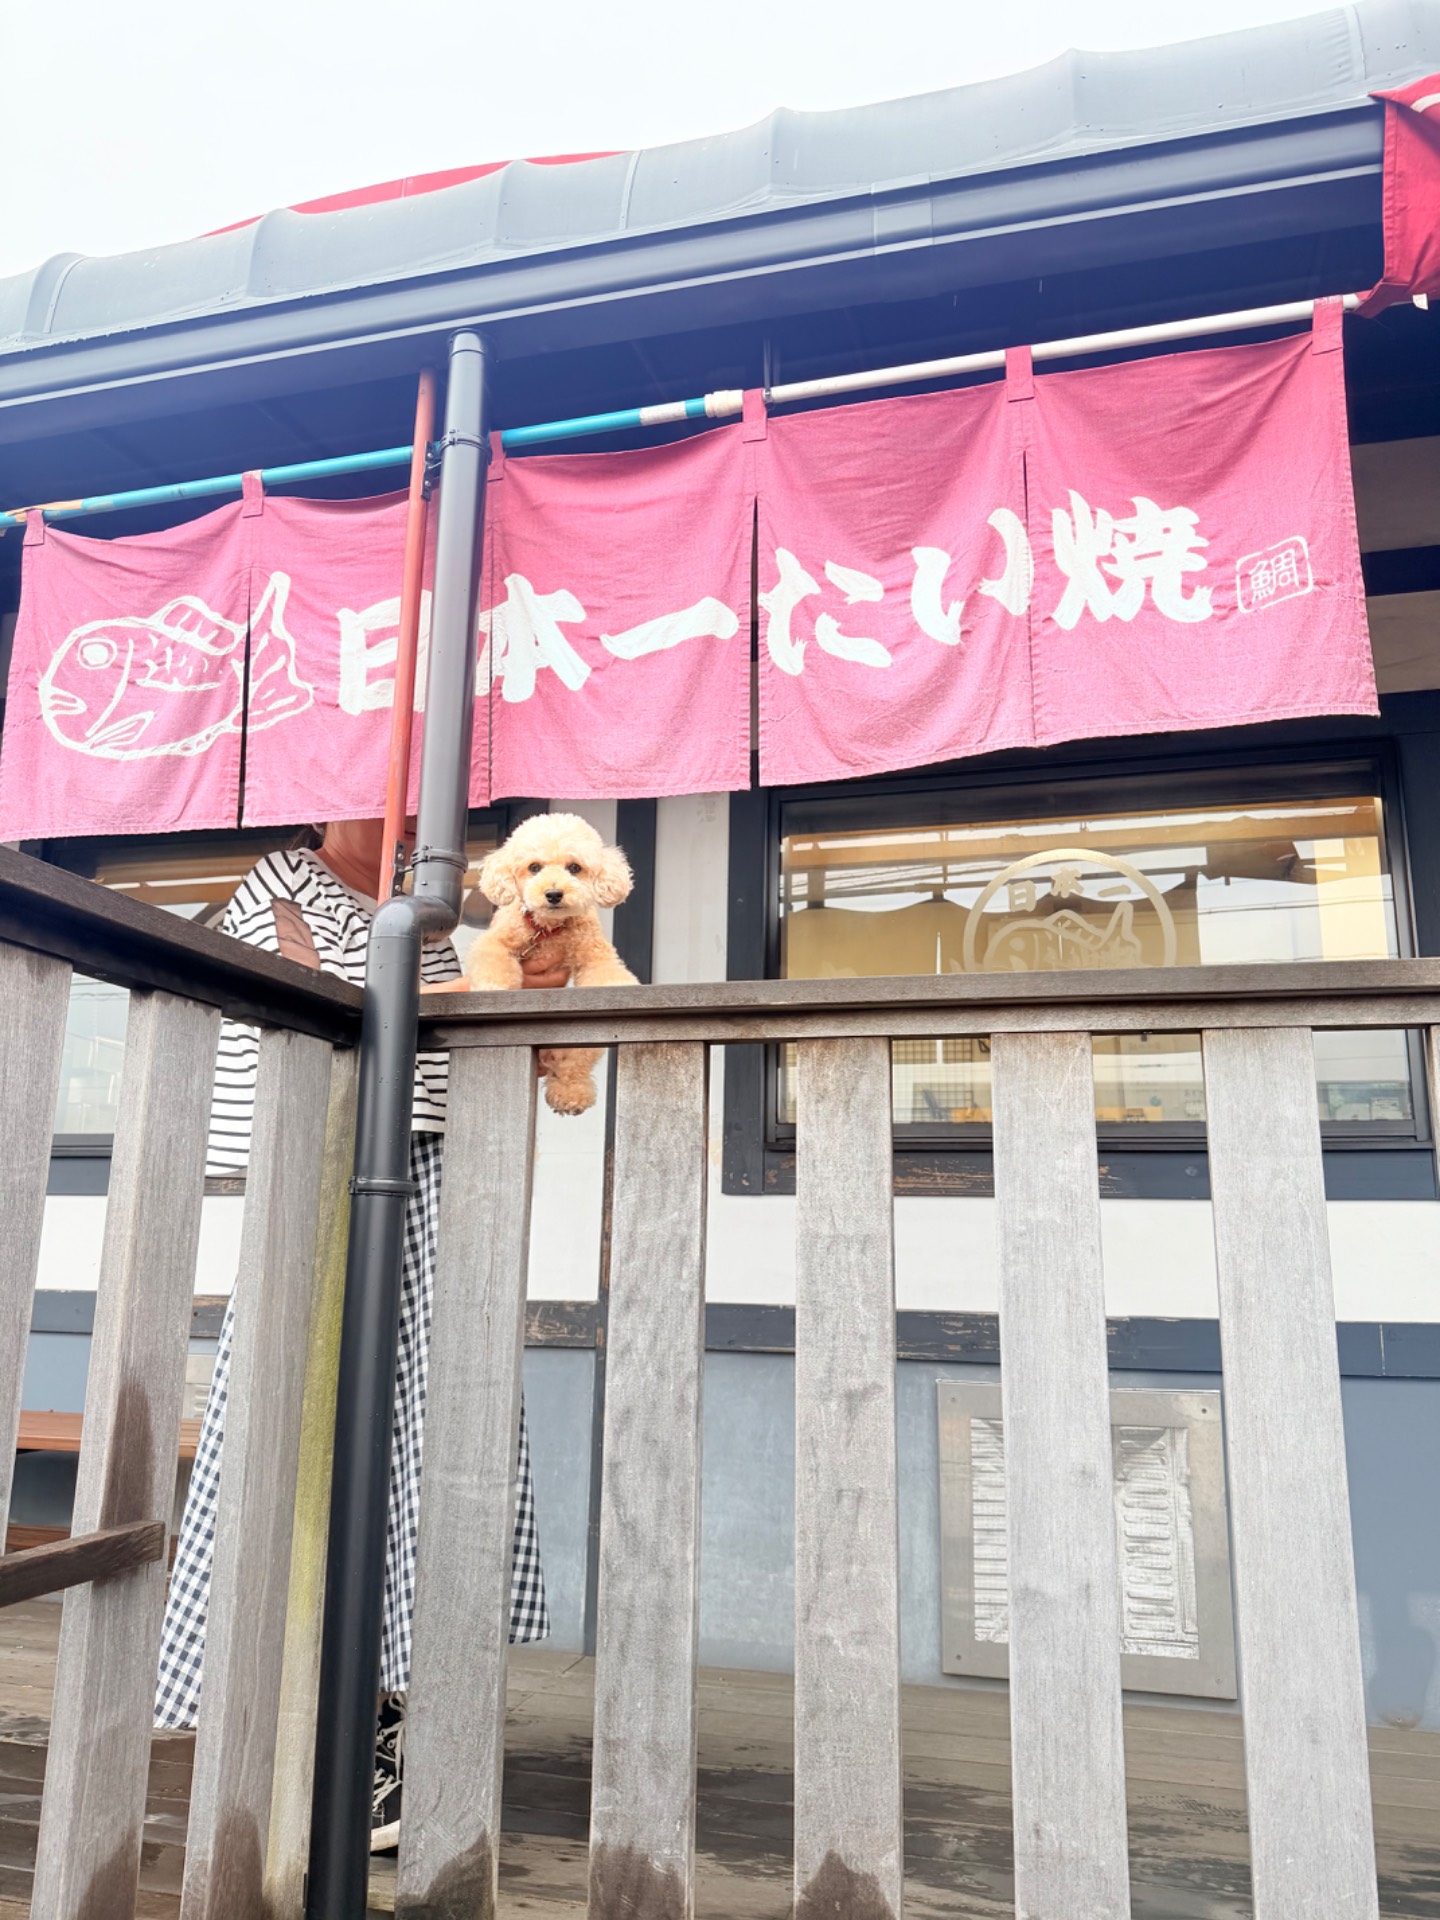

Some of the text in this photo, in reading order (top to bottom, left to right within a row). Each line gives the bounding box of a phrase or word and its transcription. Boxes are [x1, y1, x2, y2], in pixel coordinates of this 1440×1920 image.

[1248, 547, 1300, 605] 鯛
[1007, 866, 1132, 913] 日本一
